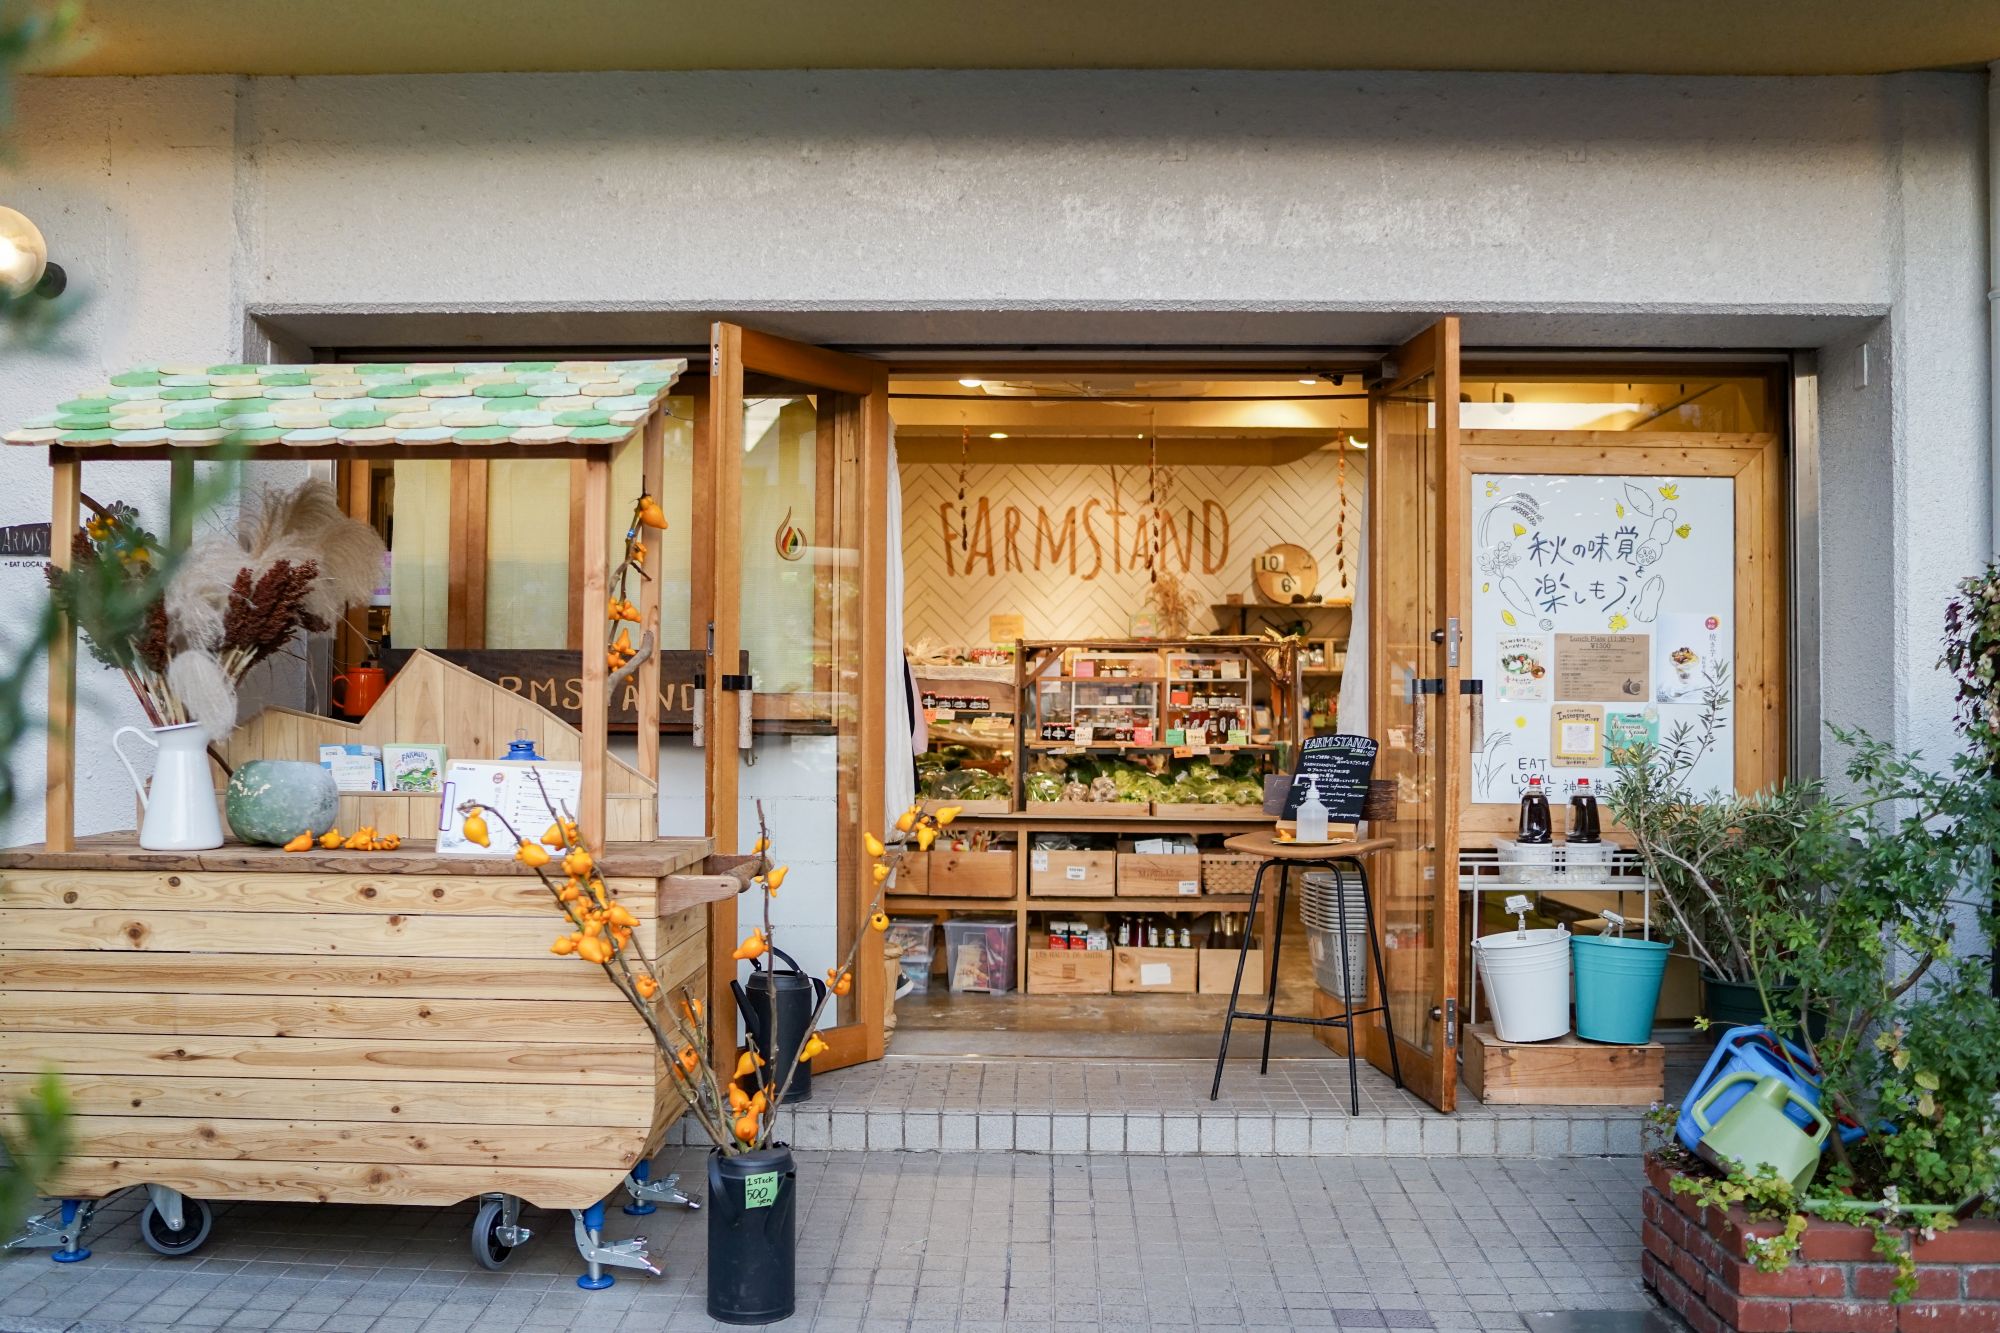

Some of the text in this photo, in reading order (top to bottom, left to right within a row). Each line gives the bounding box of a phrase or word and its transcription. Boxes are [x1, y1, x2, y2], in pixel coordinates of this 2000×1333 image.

[1303, 736, 1372, 749] FARMSTAND
[1518, 757, 1548, 771] EAT
[1518, 786, 1552, 799] KE
[747, 1187, 768, 1200] 500
